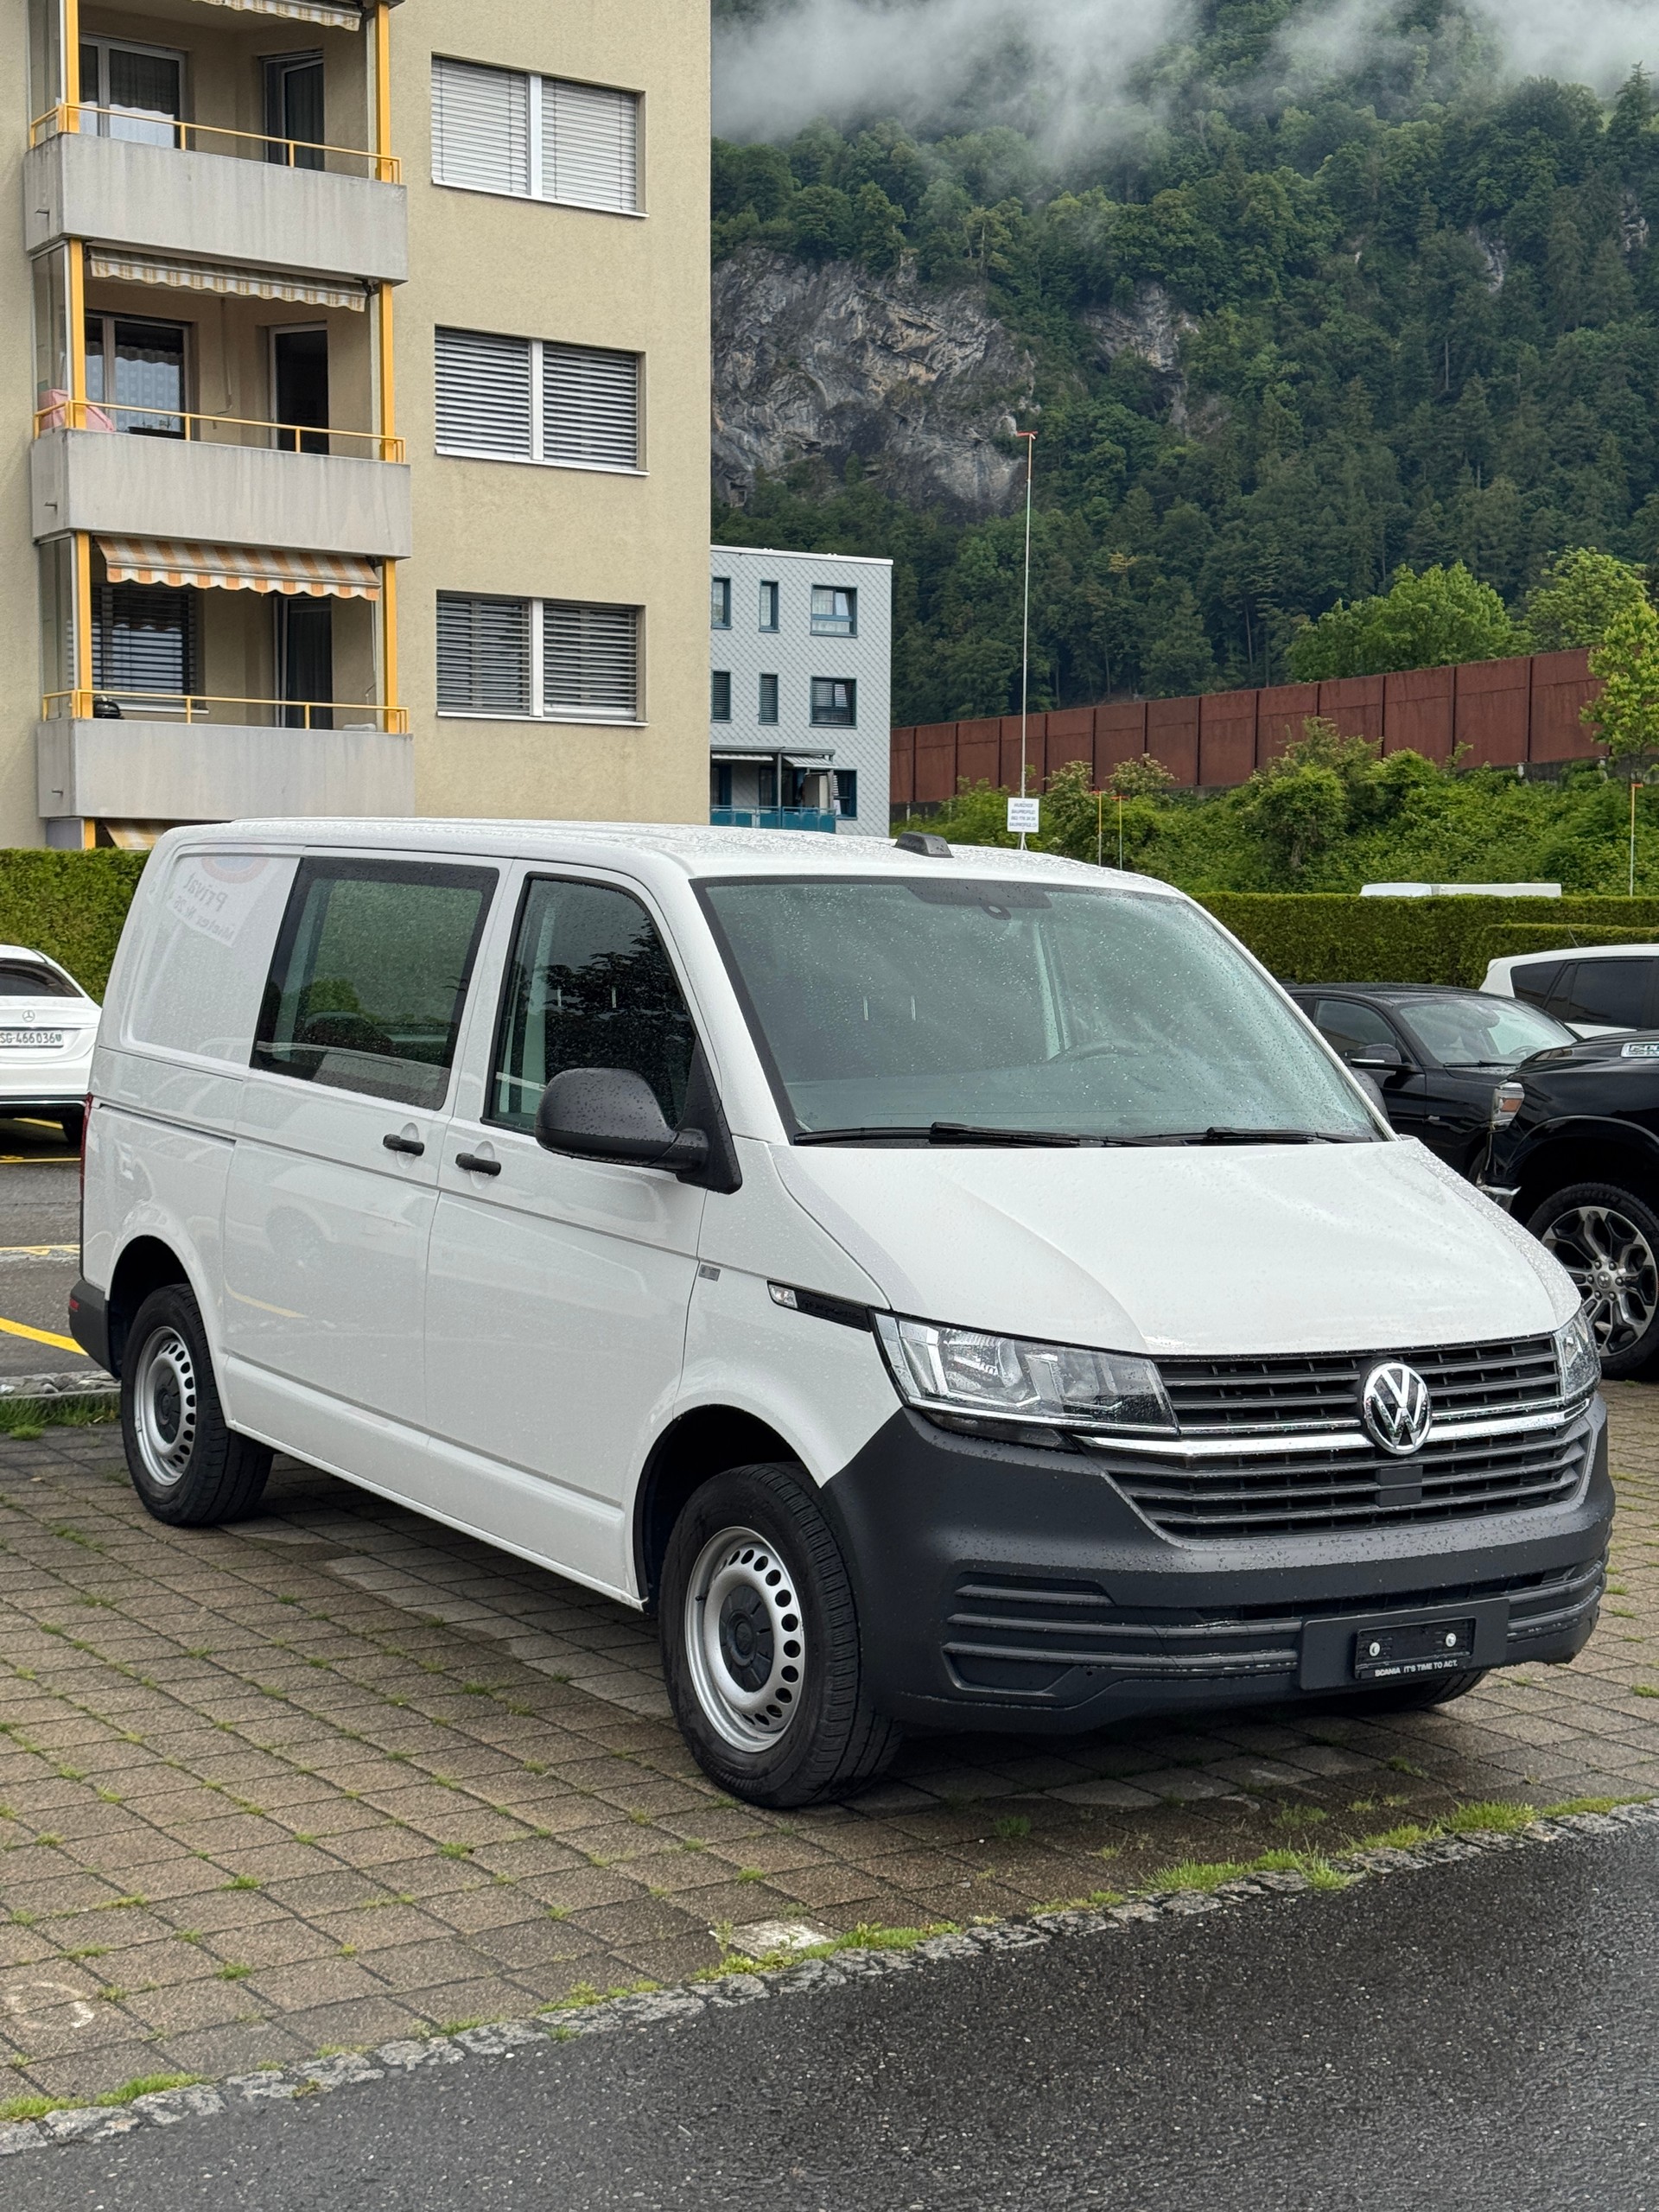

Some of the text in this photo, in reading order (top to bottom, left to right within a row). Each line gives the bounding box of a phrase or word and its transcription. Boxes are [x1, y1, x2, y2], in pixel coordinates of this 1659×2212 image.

[1375, 1668, 1401, 1677] SCANIA
[1403, 1665, 1416, 1674] IT'S
[1417, 1662, 1433, 1671] TIME
